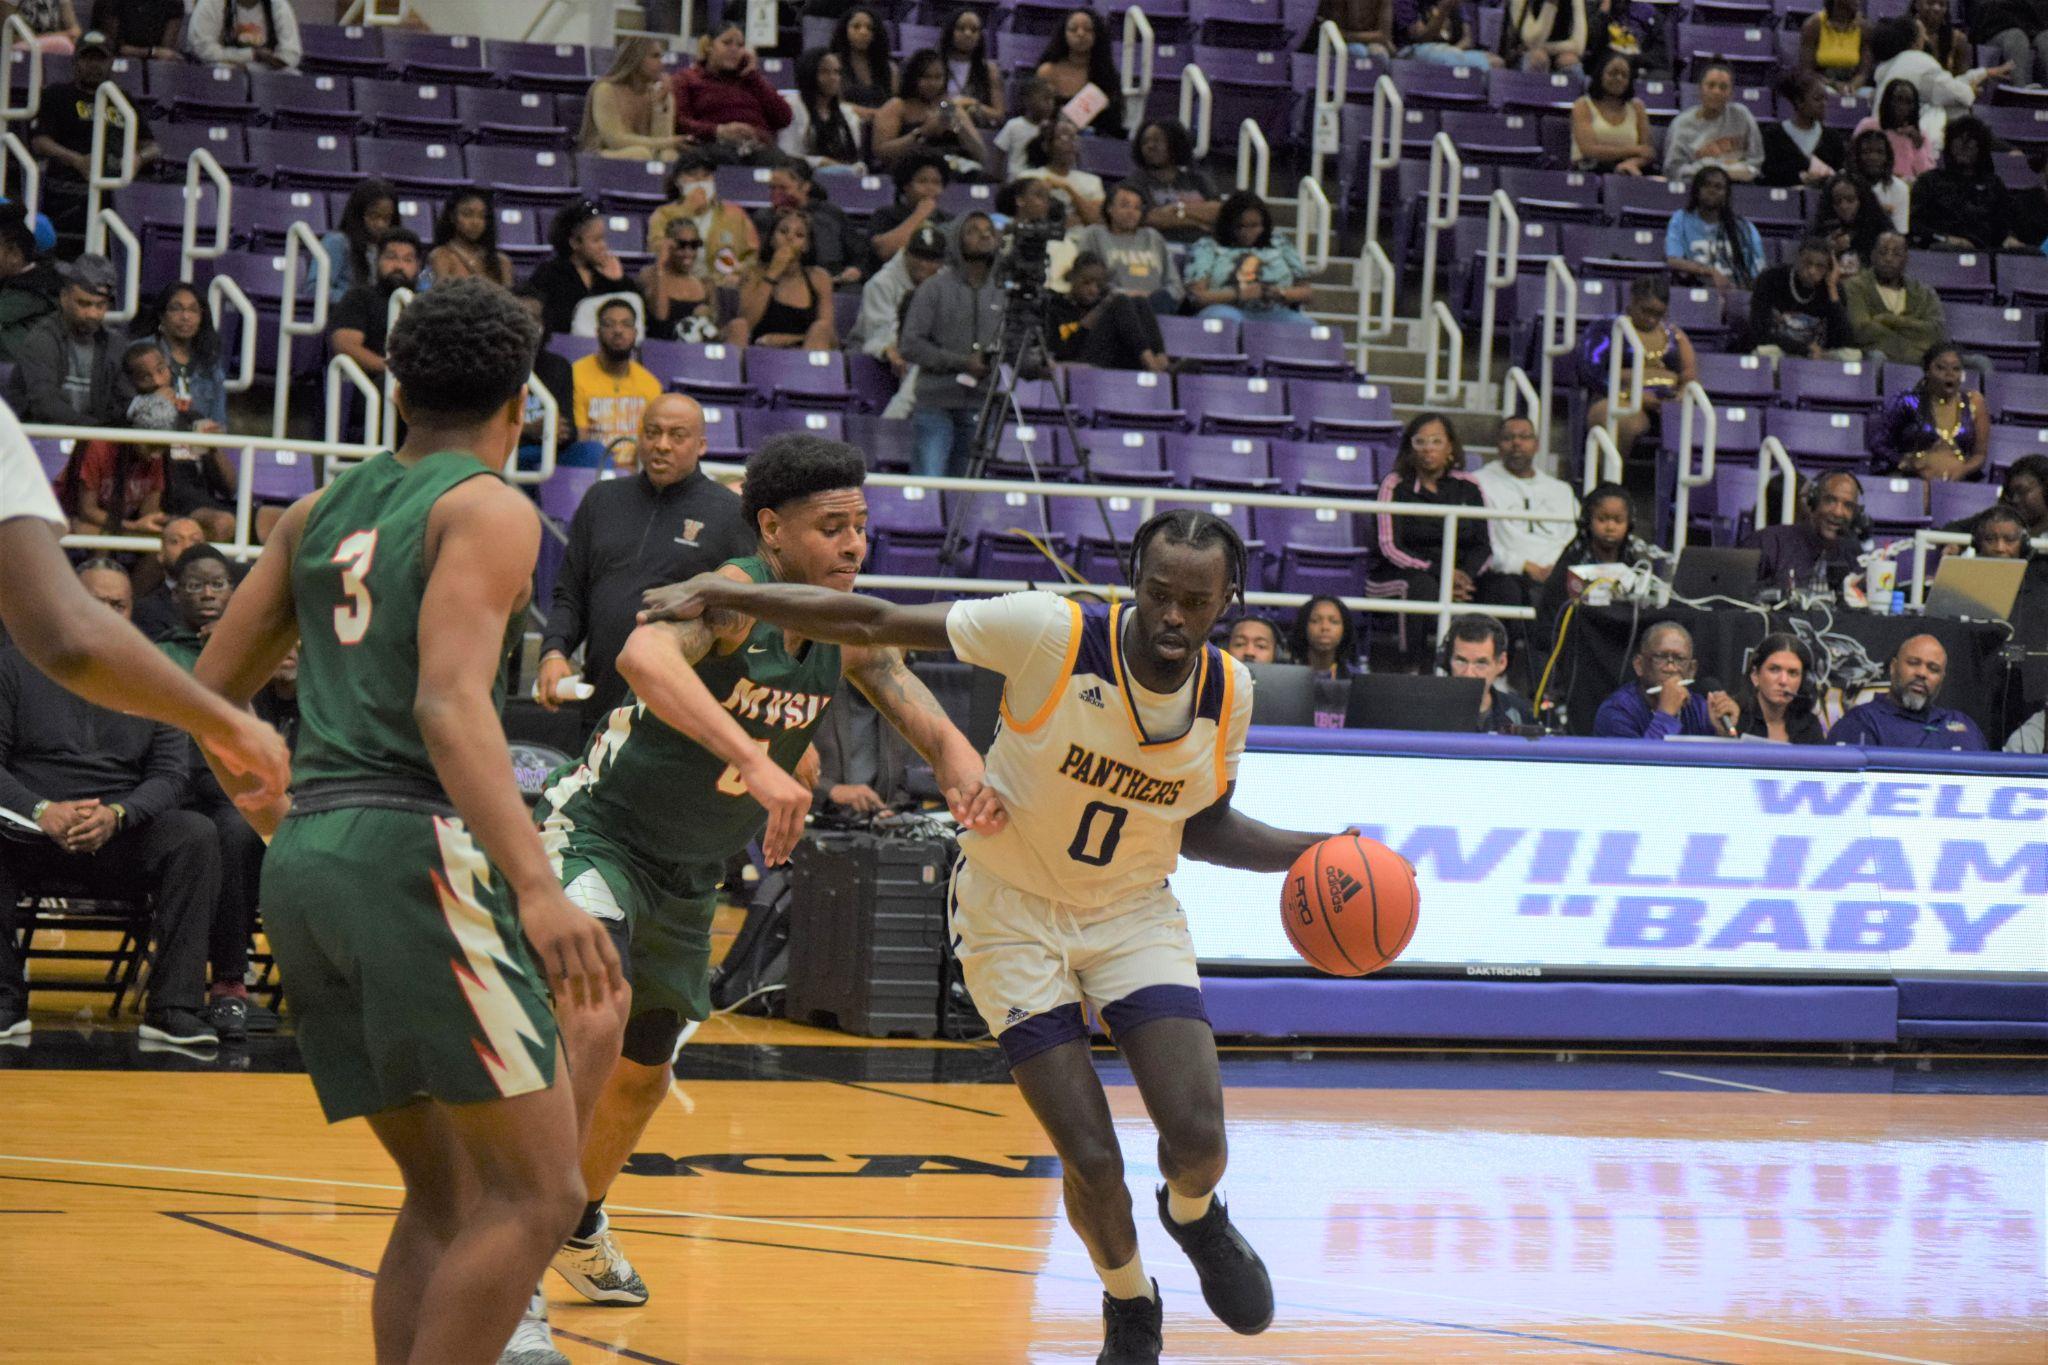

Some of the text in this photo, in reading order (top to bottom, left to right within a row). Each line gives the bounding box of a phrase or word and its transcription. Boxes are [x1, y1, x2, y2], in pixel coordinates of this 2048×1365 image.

[331, 528, 378, 646] 3
[1058, 742, 1185, 806] PANTHERS
[1752, 779, 2048, 821] WELC
[1067, 800, 1128, 867] 0
[1295, 875, 1314, 926] PRO
[1326, 865, 1343, 914] adidas
[1466, 966, 1542, 976] DAKTRONICS
